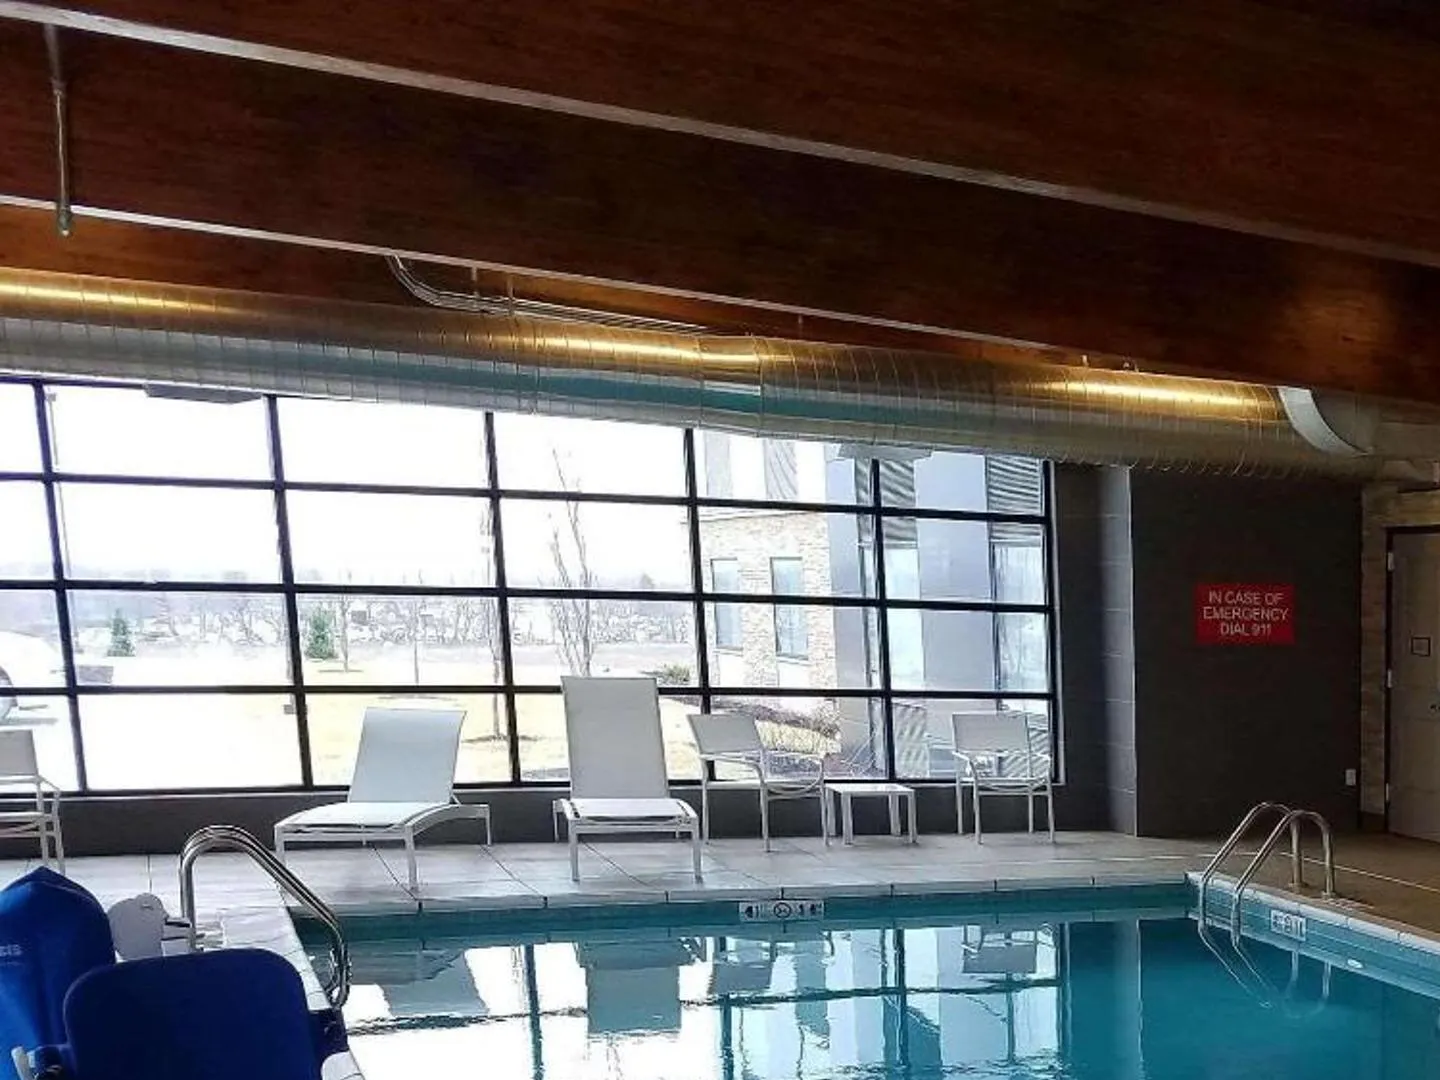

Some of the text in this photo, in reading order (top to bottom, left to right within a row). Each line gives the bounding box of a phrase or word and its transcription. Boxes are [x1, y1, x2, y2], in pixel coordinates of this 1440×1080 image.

[1208, 590, 1284, 606] IN CASE OF
[1203, 606, 1289, 621] EMERGENCY
[1220, 622, 1272, 637] DIAL 911
